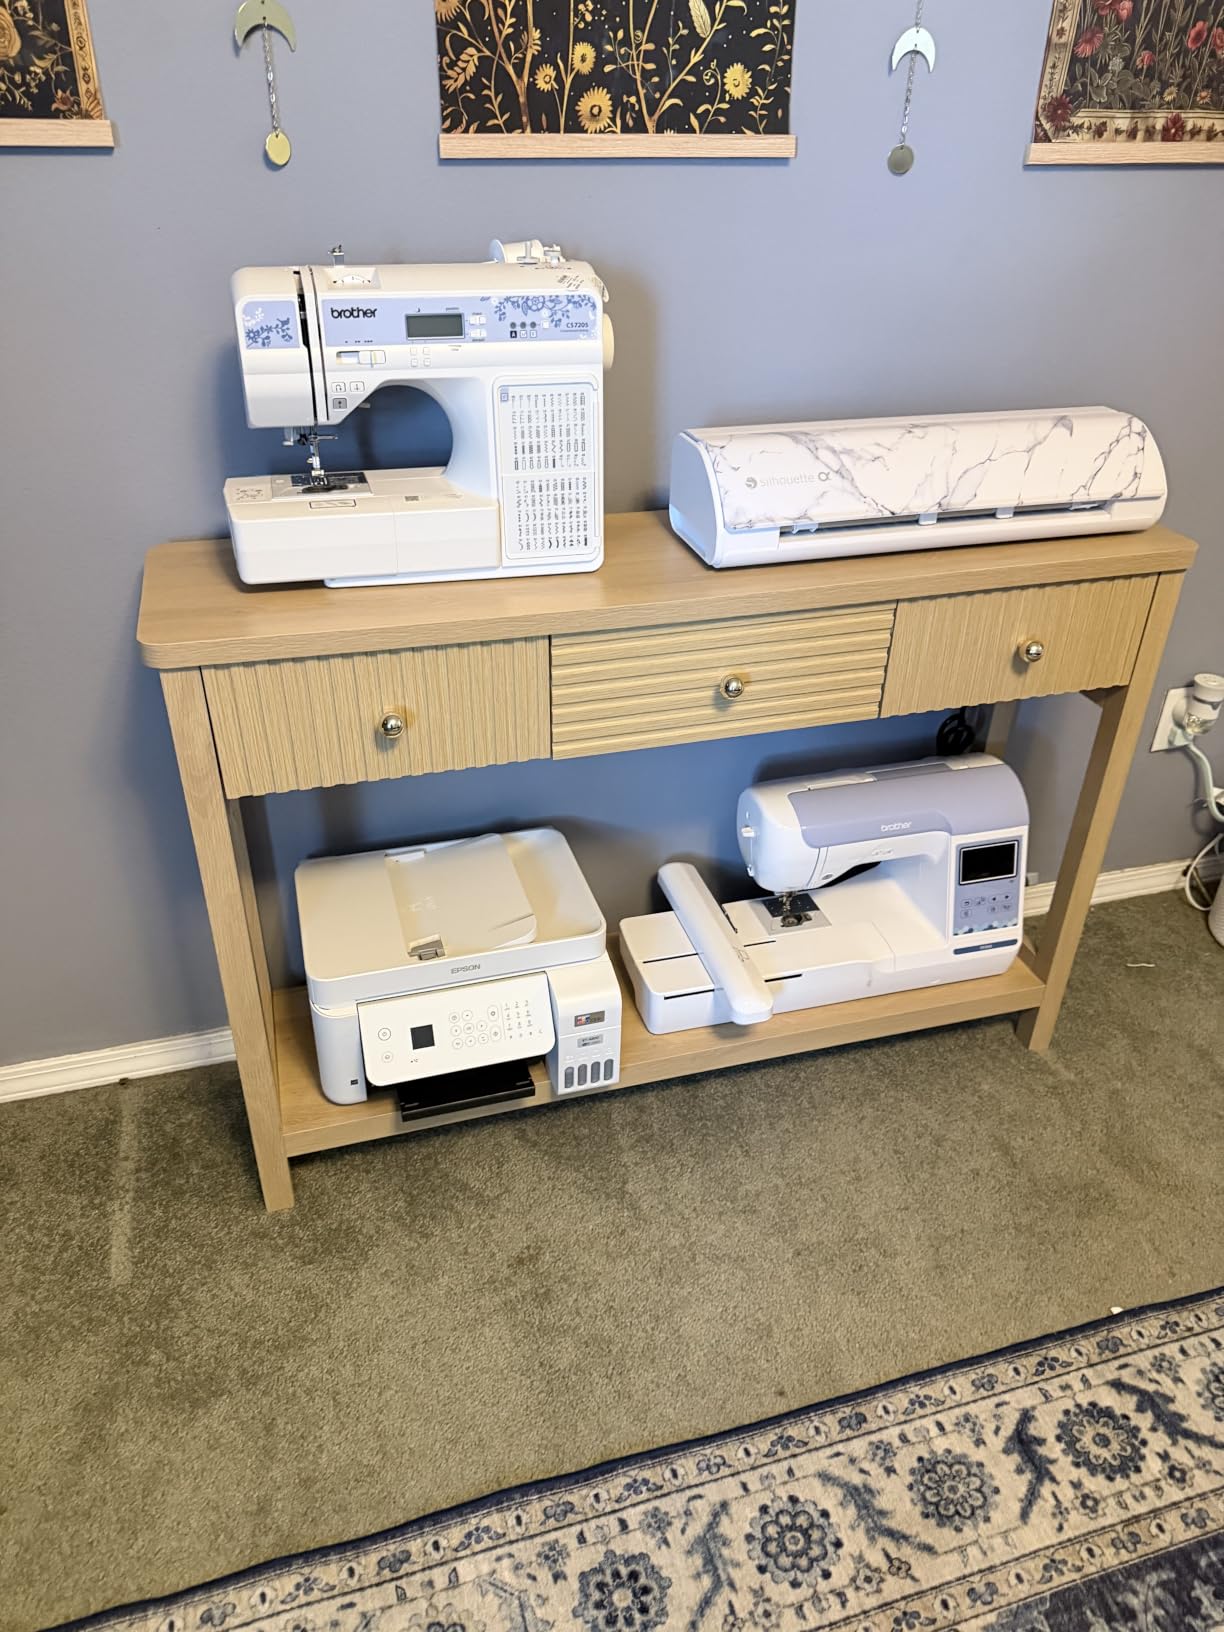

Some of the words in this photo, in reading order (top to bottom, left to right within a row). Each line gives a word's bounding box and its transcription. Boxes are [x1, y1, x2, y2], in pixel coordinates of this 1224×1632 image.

[330, 306, 377, 319] brother
[760, 474, 816, 487] silhouette
[880, 821, 912, 832] brother
[451, 964, 480, 974] EPSON
